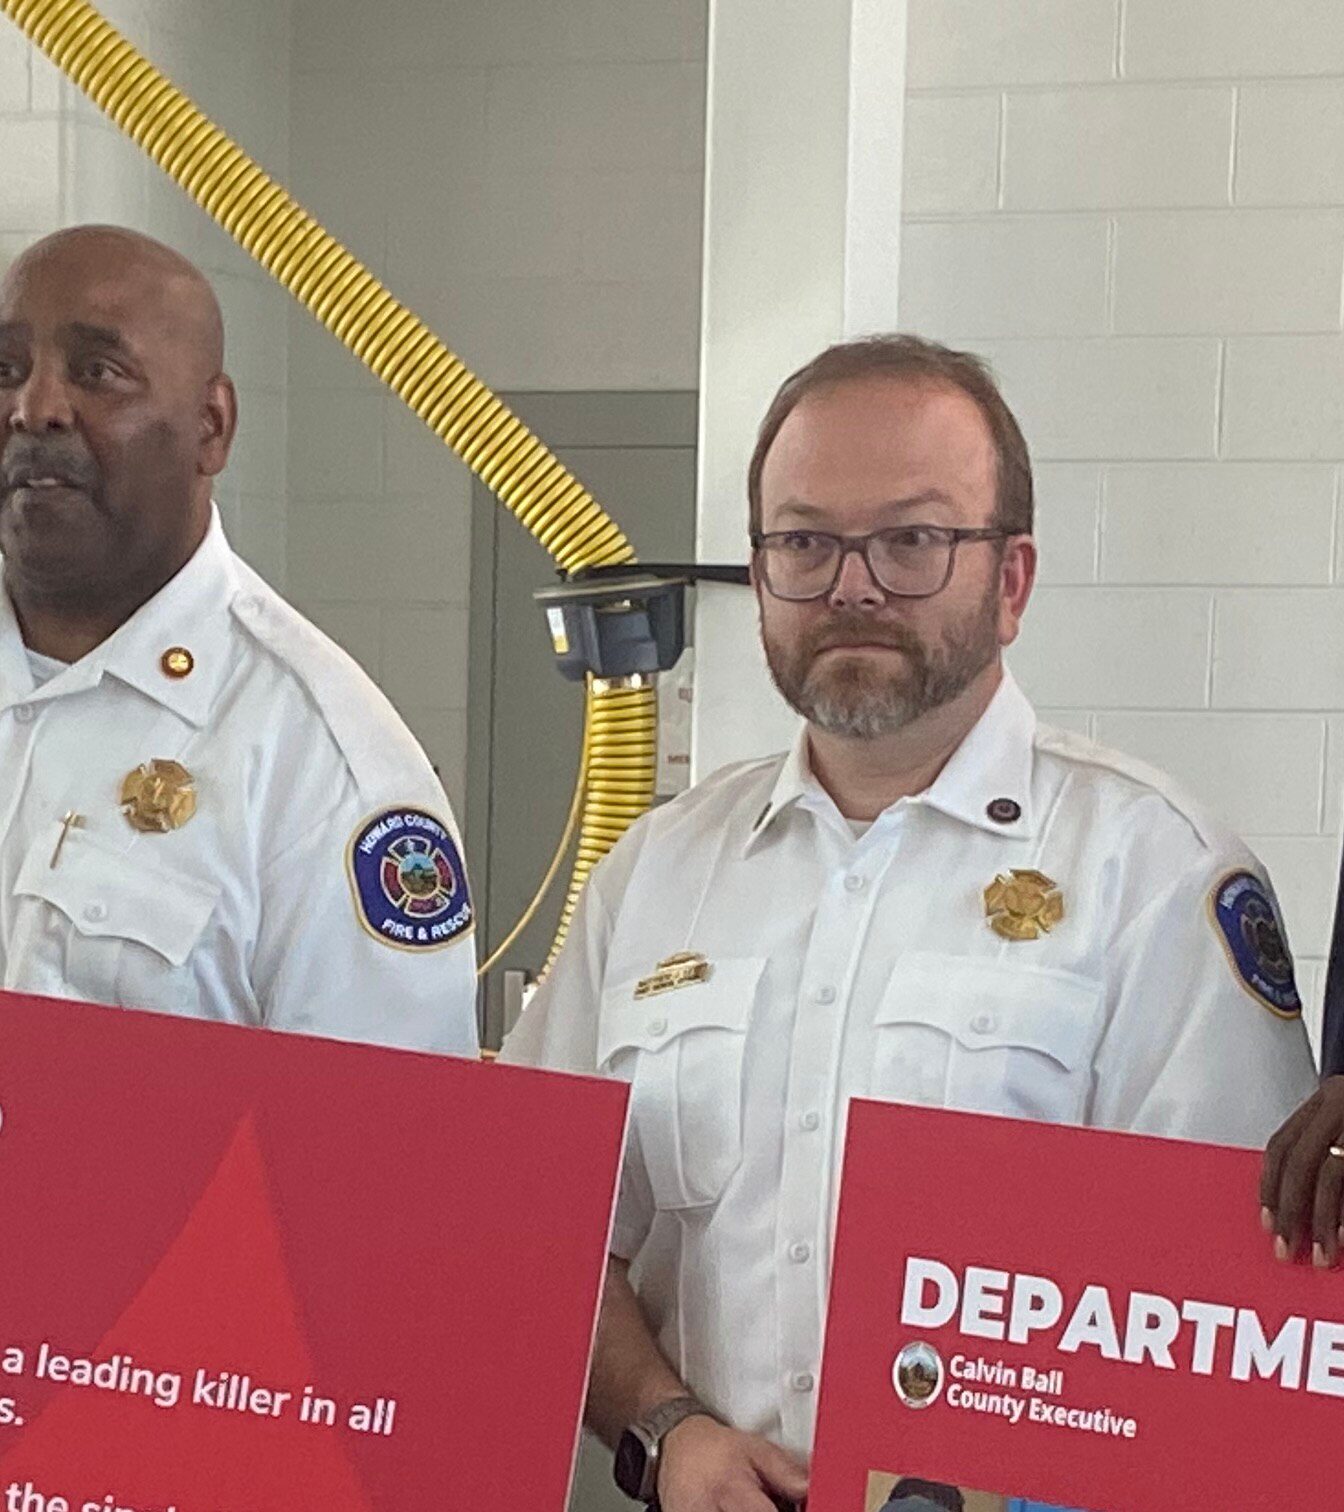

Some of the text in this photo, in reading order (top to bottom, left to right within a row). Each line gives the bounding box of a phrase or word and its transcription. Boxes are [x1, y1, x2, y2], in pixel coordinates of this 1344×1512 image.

[3, 1348, 23, 1373] a
[37, 1344, 180, 1406] leading
[193, 1370, 290, 1416] killer
[300, 1387, 335, 1424] in
[349, 1399, 395, 1434] all
[951, 1355, 1063, 1395] Calvin Ball
[947, 1384, 1136, 1437] County Executive
